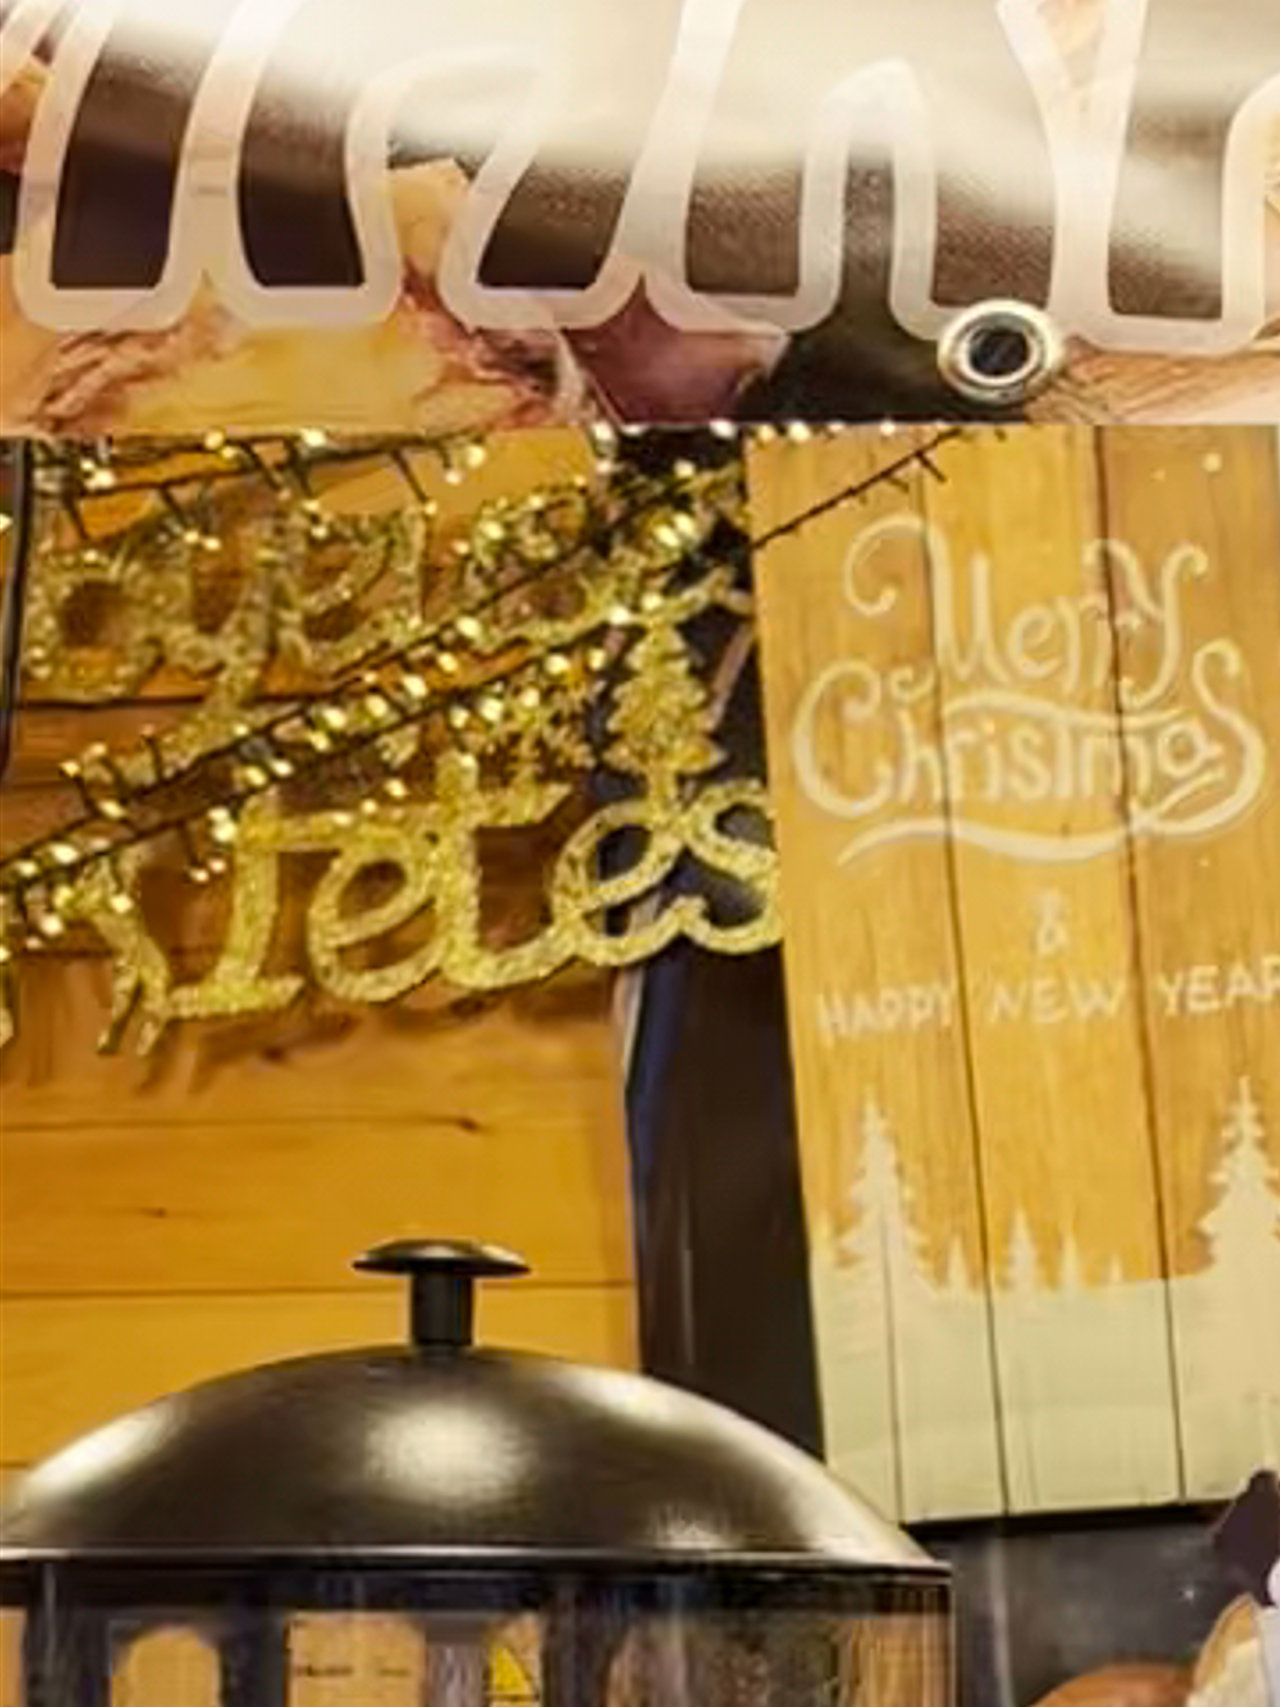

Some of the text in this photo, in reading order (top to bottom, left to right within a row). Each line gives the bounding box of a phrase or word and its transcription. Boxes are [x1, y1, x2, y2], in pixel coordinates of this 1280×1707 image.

[843, 513, 1209, 711] Merry
[791, 637, 1266, 863] Christmas
[815, 985, 958, 1049] HAPPY
[988, 977, 1131, 1026] NEW
